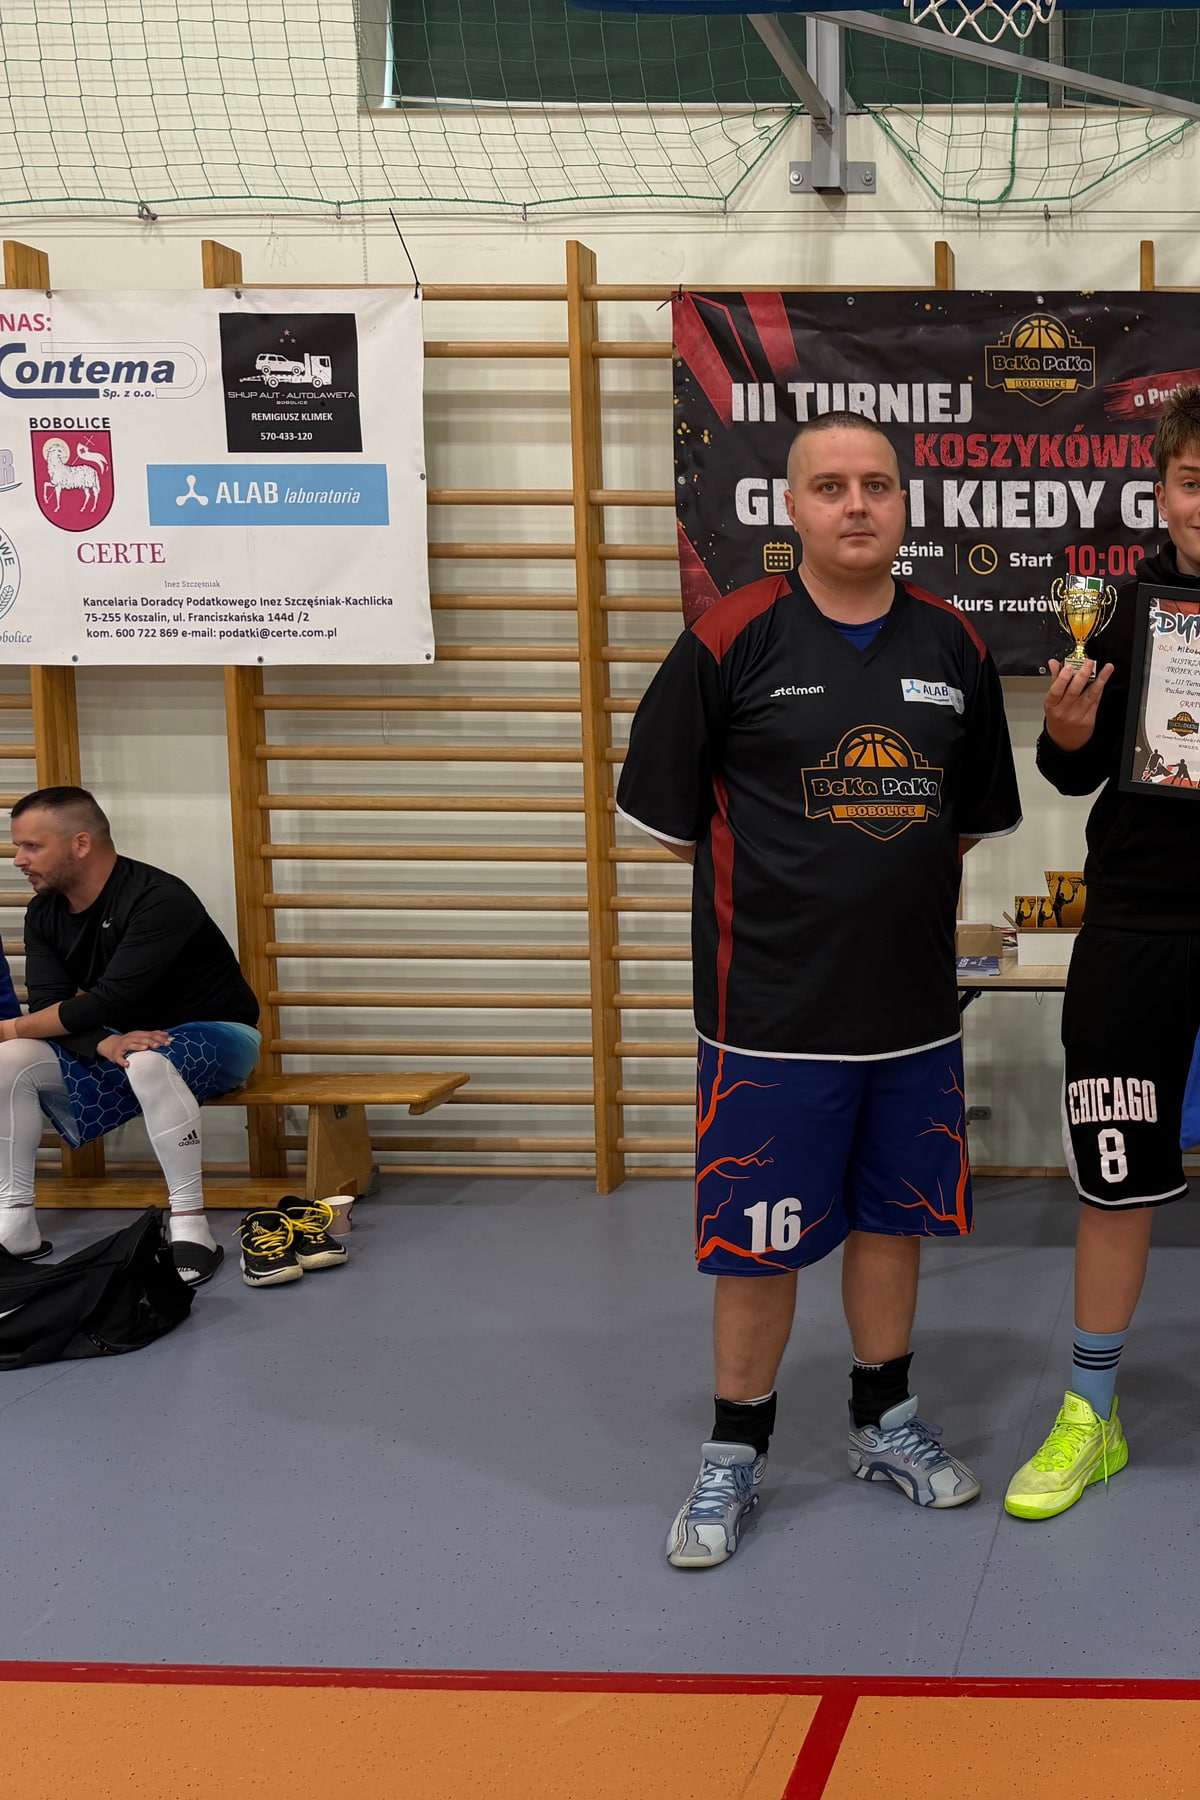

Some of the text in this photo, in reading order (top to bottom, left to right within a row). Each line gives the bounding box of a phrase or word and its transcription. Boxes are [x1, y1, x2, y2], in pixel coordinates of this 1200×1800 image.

[0, 313, 52, 332] NAS:
[0, 343, 175, 399] Contema
[992, 355, 1092, 372] BeKa PaKa
[1014, 379, 1067, 389] BOBOLICE
[102, 388, 155, 399] Sp. z o.o.
[259, 391, 281, 399] AUT
[1134, 391, 1145, 408] o
[731, 382, 973, 424] III TURNIEJ
[29, 417, 111, 429] BOBOLICE
[251, 412, 333, 421] REMIGIUSZ KLIMEK
[260, 432, 313, 441] 570-433-120
[914, 424, 1157, 469] KOSZYKÓWK
[215, 481, 361, 504] ALAB laboratoria
[942, 479, 1105, 529] KIEDY
[77, 543, 166, 563] CERTE
[896, 541, 944, 557] eśnia
[1009, 552, 1053, 568] Start
[1064, 544, 1145, 576] 10:00
[164, 580, 180, 588] Inez
[83, 596, 393, 608] Kancelaria Doradcy Podatkowego Inez Szczęśniak-Kachlicka
[999, 595, 1063, 612] rzutów
[84, 611, 310, 624] 75-255 Koszalin, ul. Franciszkańska 144d /2
[86, 627, 337, 639] kom. 600 722 869 e-mail: podatki@certe.com.pl
[811, 777, 938, 797] BeKa PaKa
[846, 806, 916, 817] BOBOLICE
[1068, 1076, 1158, 1125] CHICAGO
[1097, 1128, 1128, 1184] 8
[744, 1197, 802, 1253] 16
